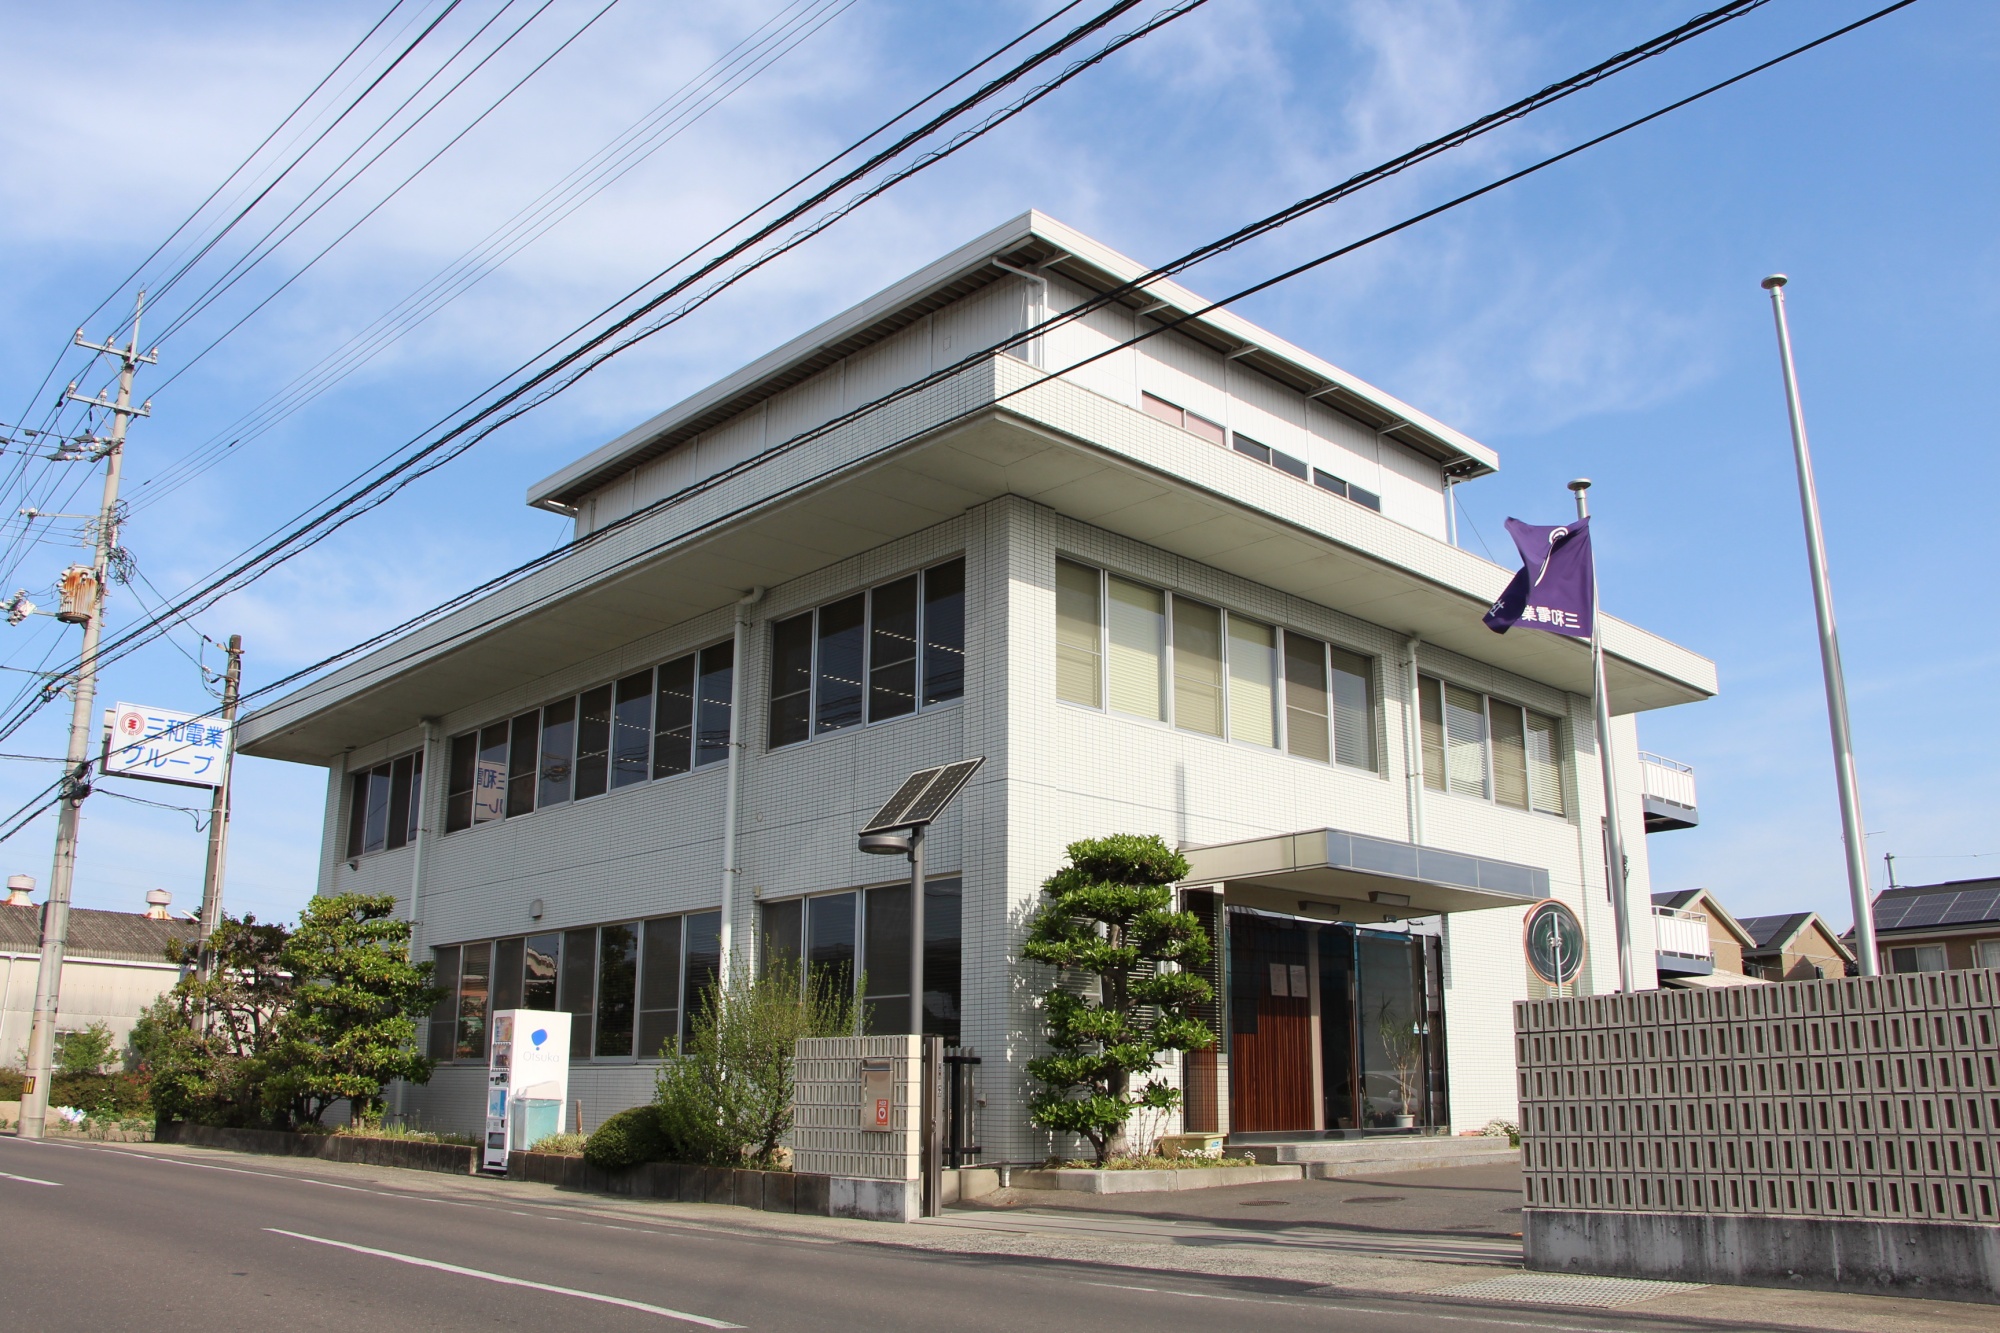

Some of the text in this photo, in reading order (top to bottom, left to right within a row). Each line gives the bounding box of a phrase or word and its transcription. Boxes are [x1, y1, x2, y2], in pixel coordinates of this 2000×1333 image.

[144, 716, 223, 749] 三和電業
[122, 744, 215, 775] グループ
[522, 1050, 560, 1063] Otsuka
